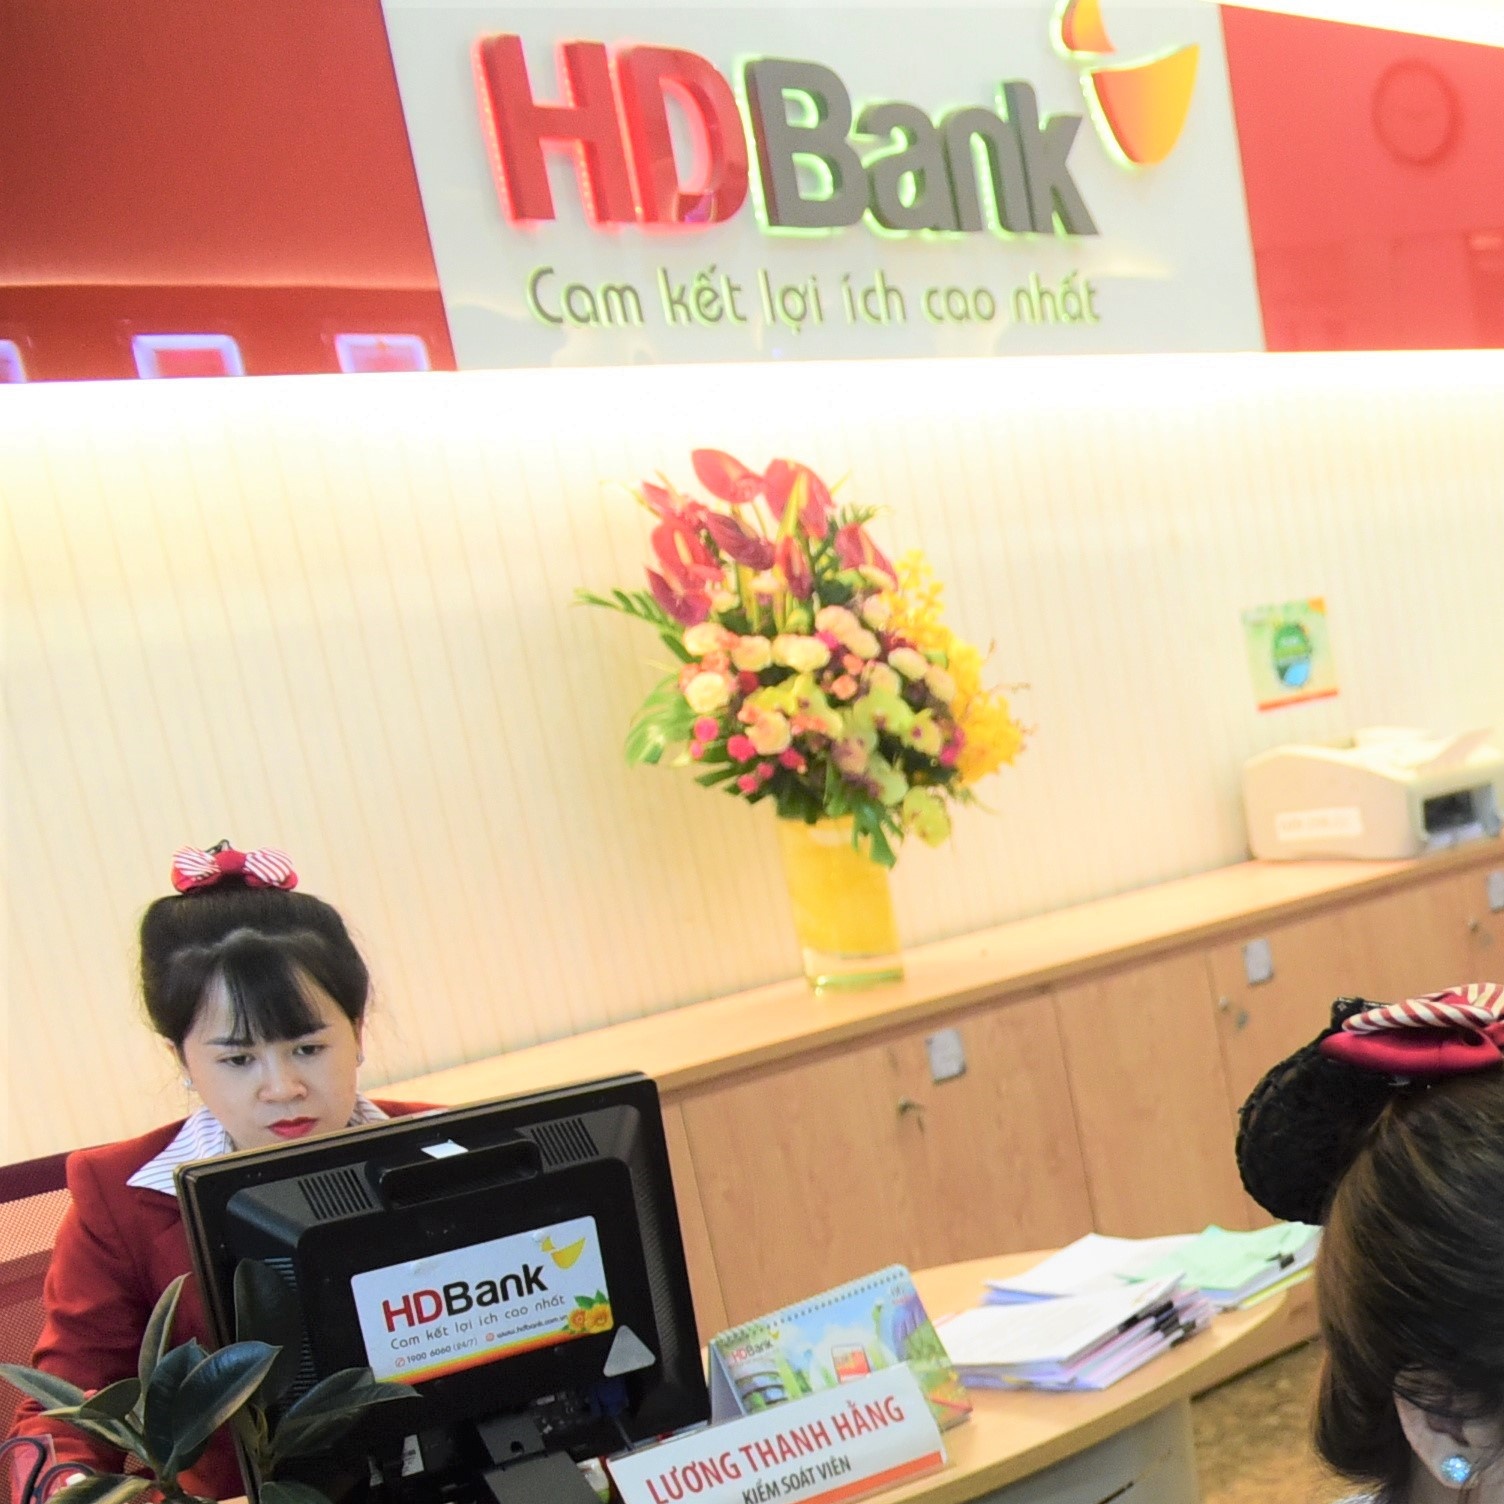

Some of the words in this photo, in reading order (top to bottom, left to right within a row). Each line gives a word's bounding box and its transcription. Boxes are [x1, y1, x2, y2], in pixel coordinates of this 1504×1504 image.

[474, 32, 1100, 237] HDBank
[527, 266, 643, 327] Cam
[660, 262, 742, 326] kết
[760, 267, 819, 333] lợi
[842, 269, 905, 325] ích
[922, 280, 995, 325] cao
[1010, 272, 1101, 326] nhất
[382, 1264, 548, 1332] HDBank
[391, 1334, 420, 1350] Cam
[426, 1326, 449, 1340] kết
[455, 1318, 473, 1334] lợi
[505, 1306, 529, 1320] cao
[535, 1294, 566, 1313] nhất
[496, 1314, 569, 1340] www.hdbank.com.vn
[406, 1351, 427, 1364] 1900
[430, 1345, 452, 1359] 6060
[738, 1421, 832, 1473] THANH
[780, 1466, 817, 1495] SOÁT
[818, 1455, 851, 1481] VIÊN
